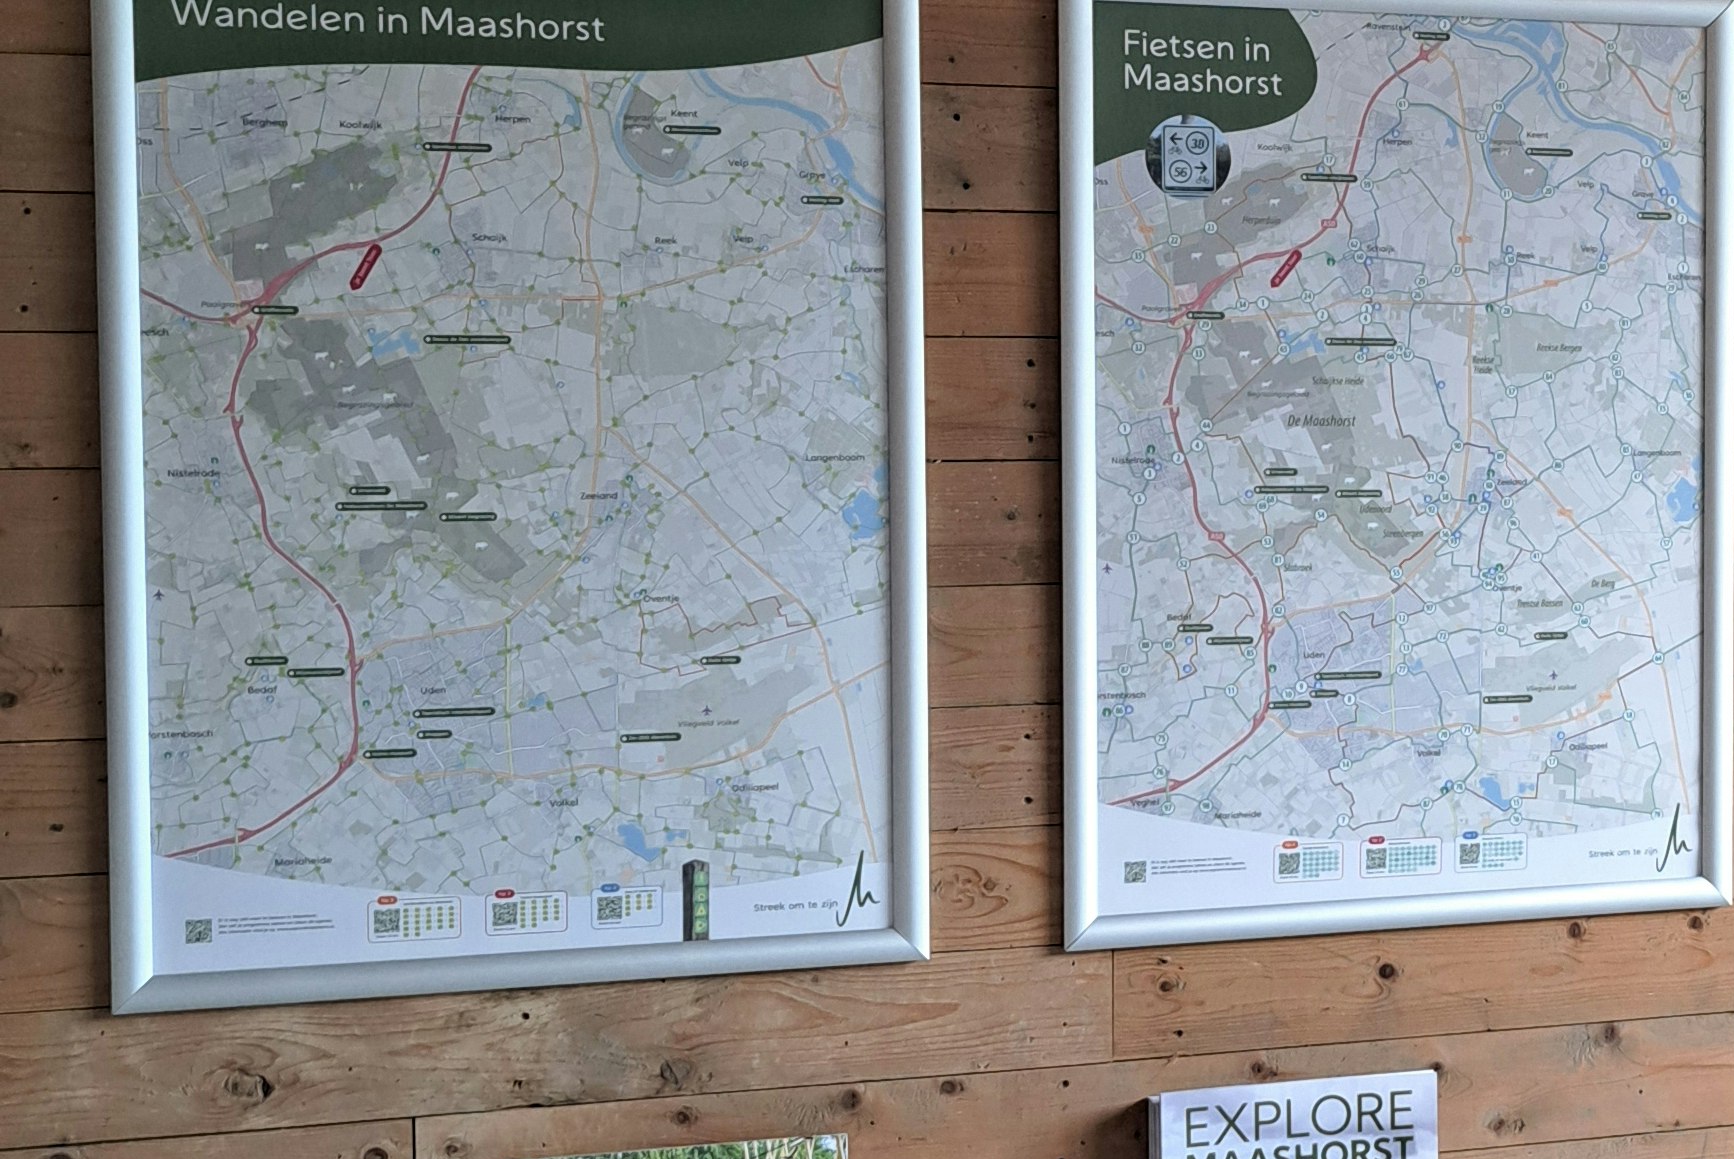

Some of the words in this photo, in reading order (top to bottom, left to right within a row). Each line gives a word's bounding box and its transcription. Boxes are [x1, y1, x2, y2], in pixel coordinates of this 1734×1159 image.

[171, 0, 365, 33] Wandelen
[377, 6, 409, 35] in
[420, 7, 606, 42] Maashorst
[1124, 28, 1235, 60] Fietsen
[1245, 37, 1271, 63] in
[1124, 64, 1283, 96] Maashorst
[670, 109, 698, 119] Keent
[339, 119, 383, 131] Koolwijk
[1257, 144, 1293, 153] Koolwijk
[728, 159, 749, 169] Velp
[1173, 168, 1187, 177] 56
[655, 236, 678, 245] Reek
[734, 235, 754, 244] Velp
[1288, 415, 1301, 426] De
[1303, 415, 1356, 427] Maashorst
[806, 454, 865, 463] Langenboom
[167, 469, 221, 478] Nistelrode
[580, 491, 618, 500] Zeeland
[1591, 580, 1600, 588] De
[1601, 580, 1616, 589] Berg
[643, 594, 680, 604] Oventje
[248, 685, 277, 695] Bedaf
[420, 686, 446, 695] Uden
[732, 783, 779, 793] Odiliapeel
[550, 798, 579, 808] Volkel
[1130, 799, 1160, 808] Veghel
[1588, 849, 1615, 858] Streek
[1644, 847, 1658, 856] zijn
[274, 856, 333, 867] Mariaheide
[754, 902, 786, 913] Streek
[789, 903, 807, 911] om
[810, 901, 820, 910] te
[823, 899, 839, 911] zijn
[1185, 1089, 1415, 1149] EXPLORE
